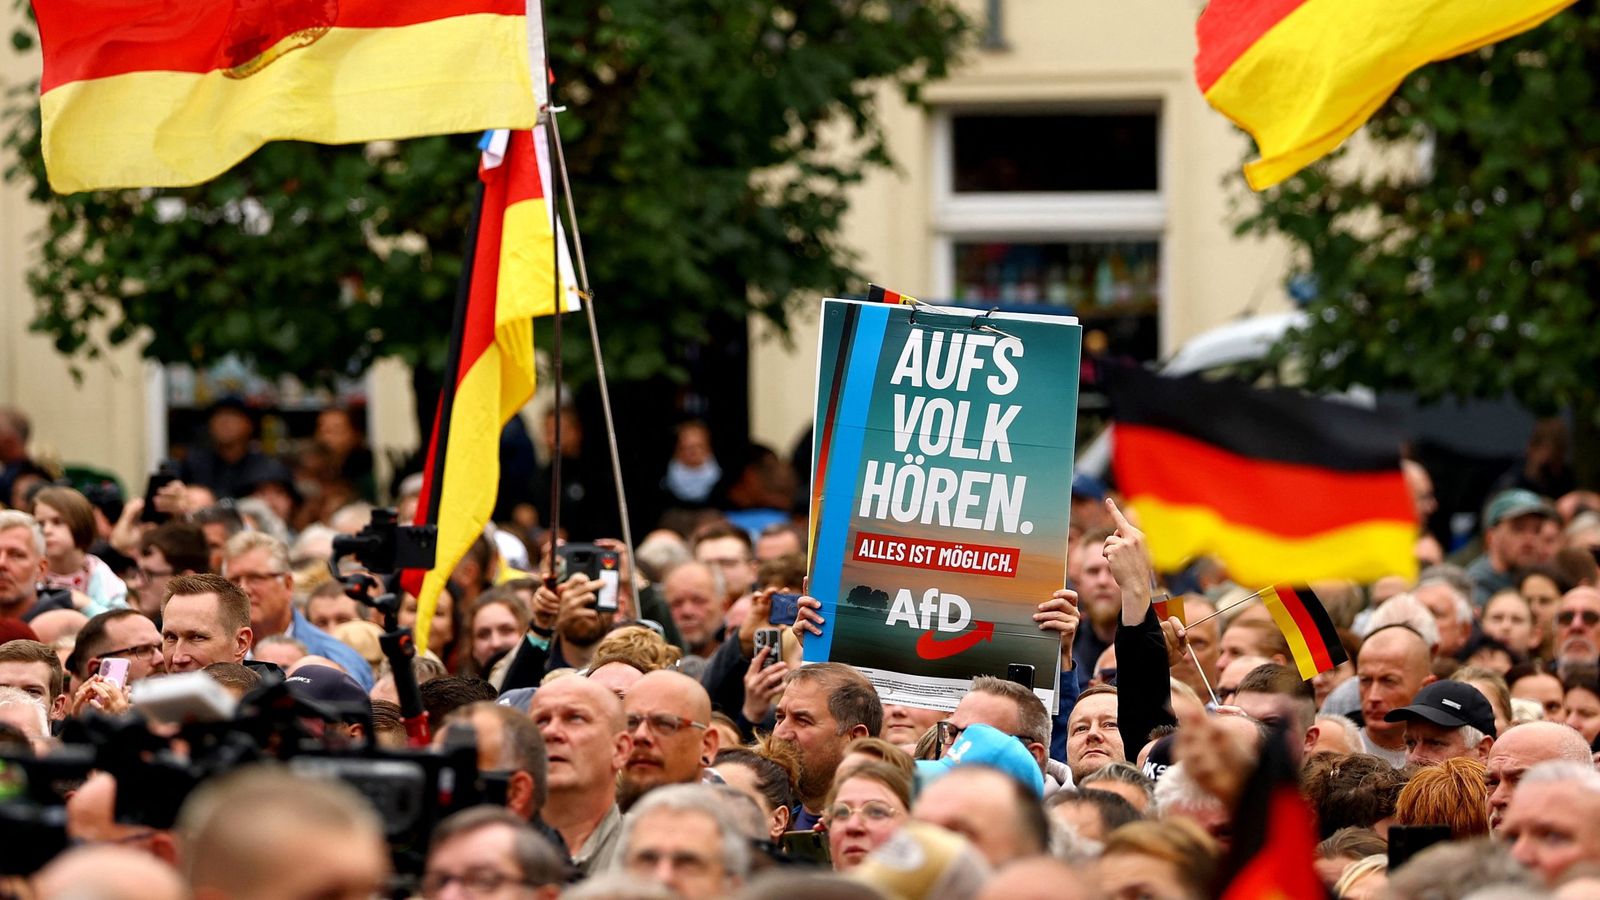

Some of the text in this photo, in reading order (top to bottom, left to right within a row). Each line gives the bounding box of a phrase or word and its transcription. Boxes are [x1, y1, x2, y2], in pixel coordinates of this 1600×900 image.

[890, 329, 1024, 395] AUFS
[894, 393, 1022, 463] VOLK
[858, 454, 1034, 534] HÖREN.
[858, 539, 1013, 573] ALLES IST MÖGLICH.
[885, 588, 972, 633] AfD
